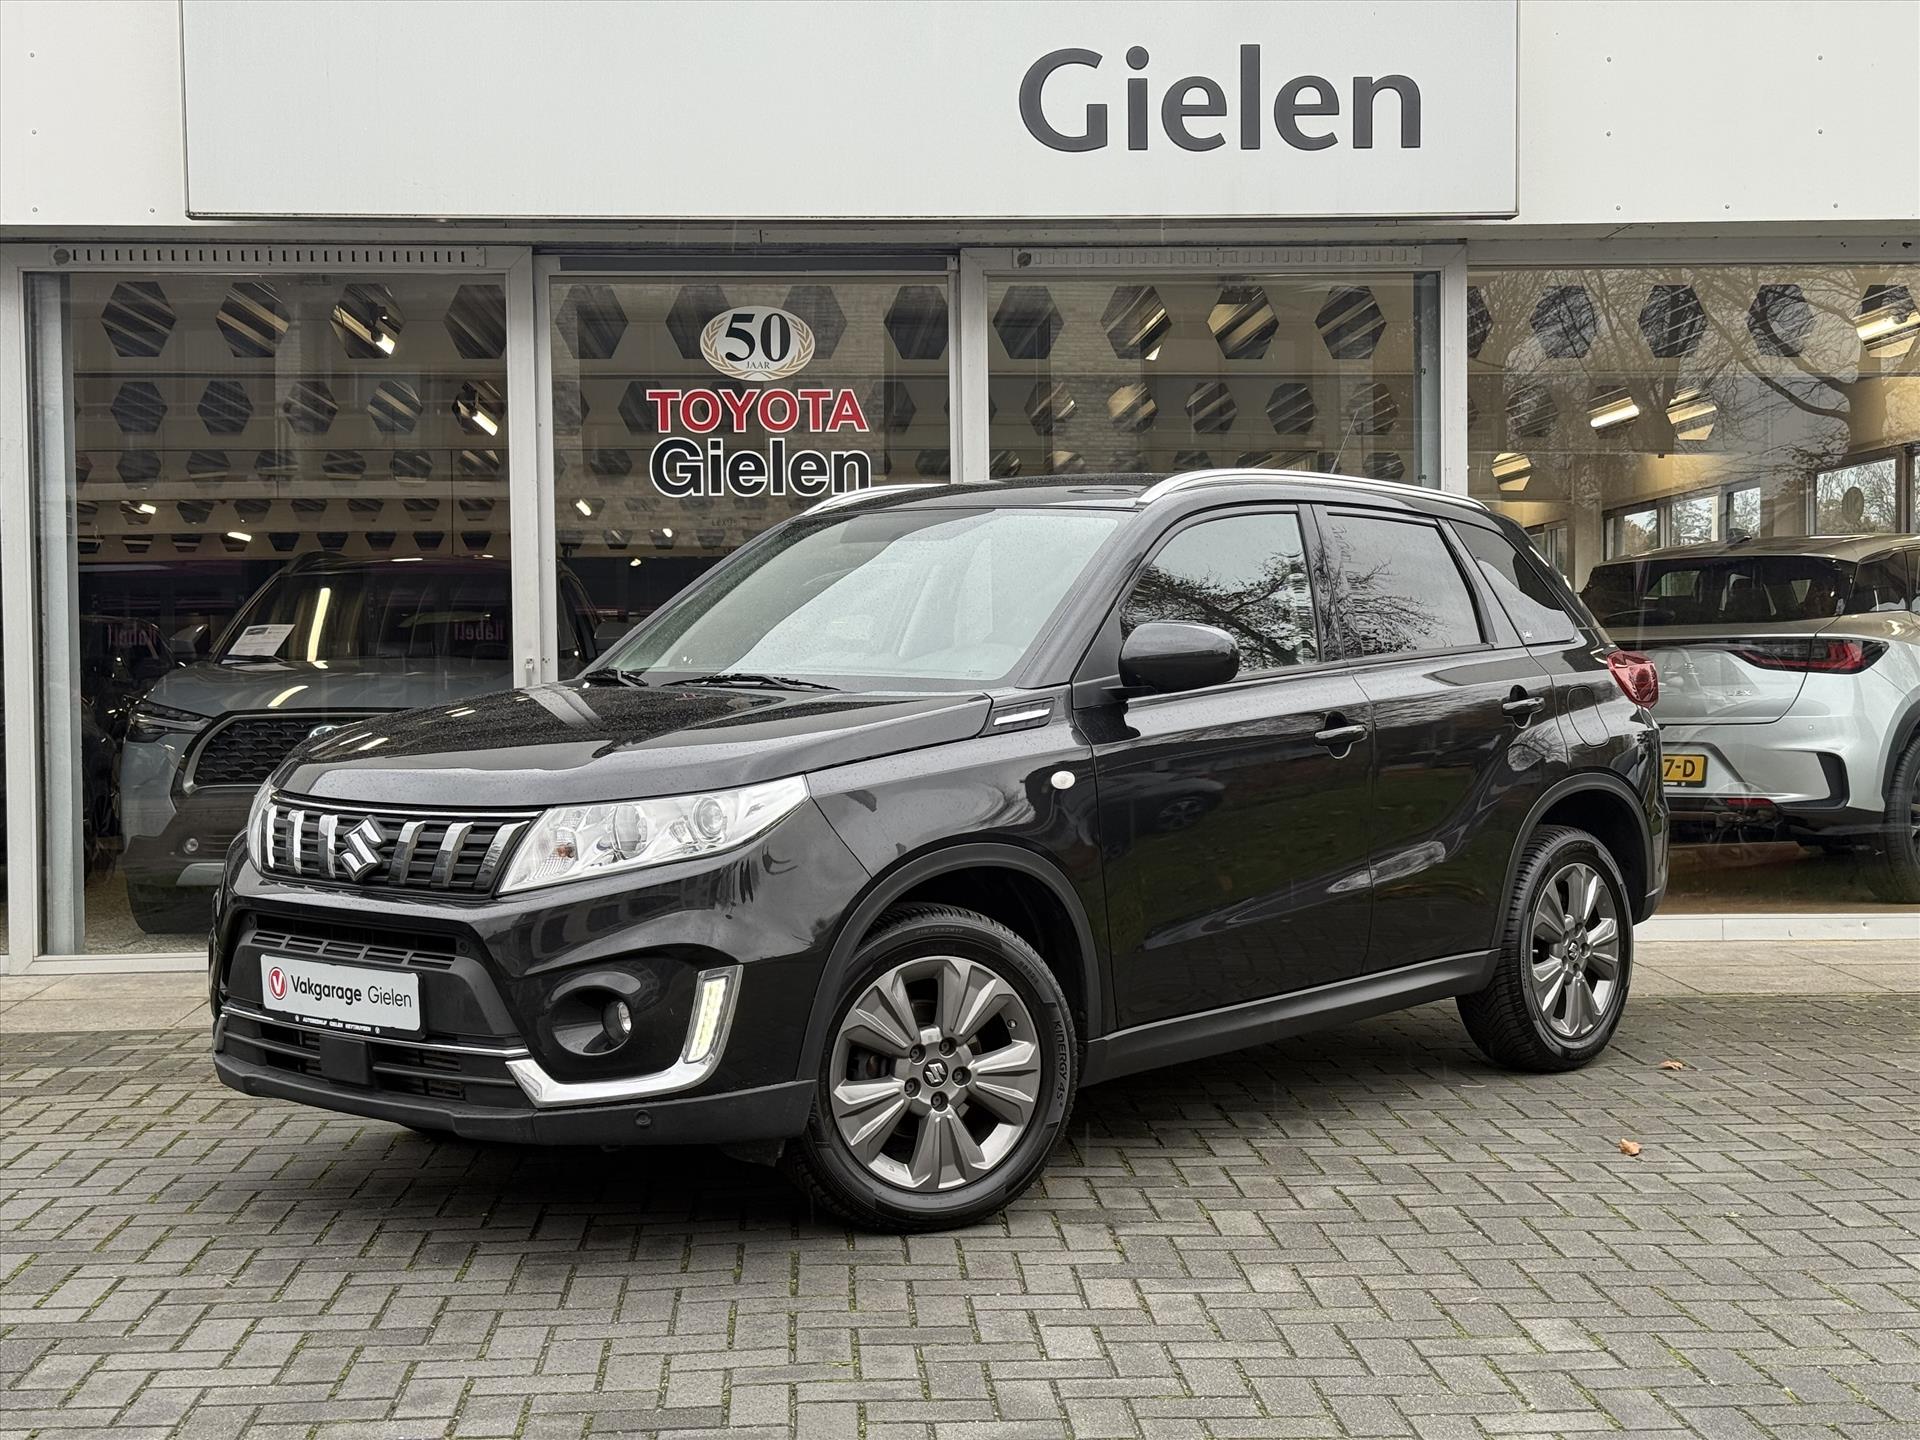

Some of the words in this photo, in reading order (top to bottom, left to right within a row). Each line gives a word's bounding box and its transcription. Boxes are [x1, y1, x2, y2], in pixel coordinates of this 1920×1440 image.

[1018, 43, 1421, 152] Gielen
[724, 313, 791, 362] 50
[746, 361, 770, 369] JAAR
[646, 389, 870, 433] TOYOTA
[650, 437, 872, 497] Gielen
[290, 974, 362, 1006] Vakgarage
[367, 985, 412, 1008] Gielen
[1054, 1021, 1068, 1080] KINERGY
